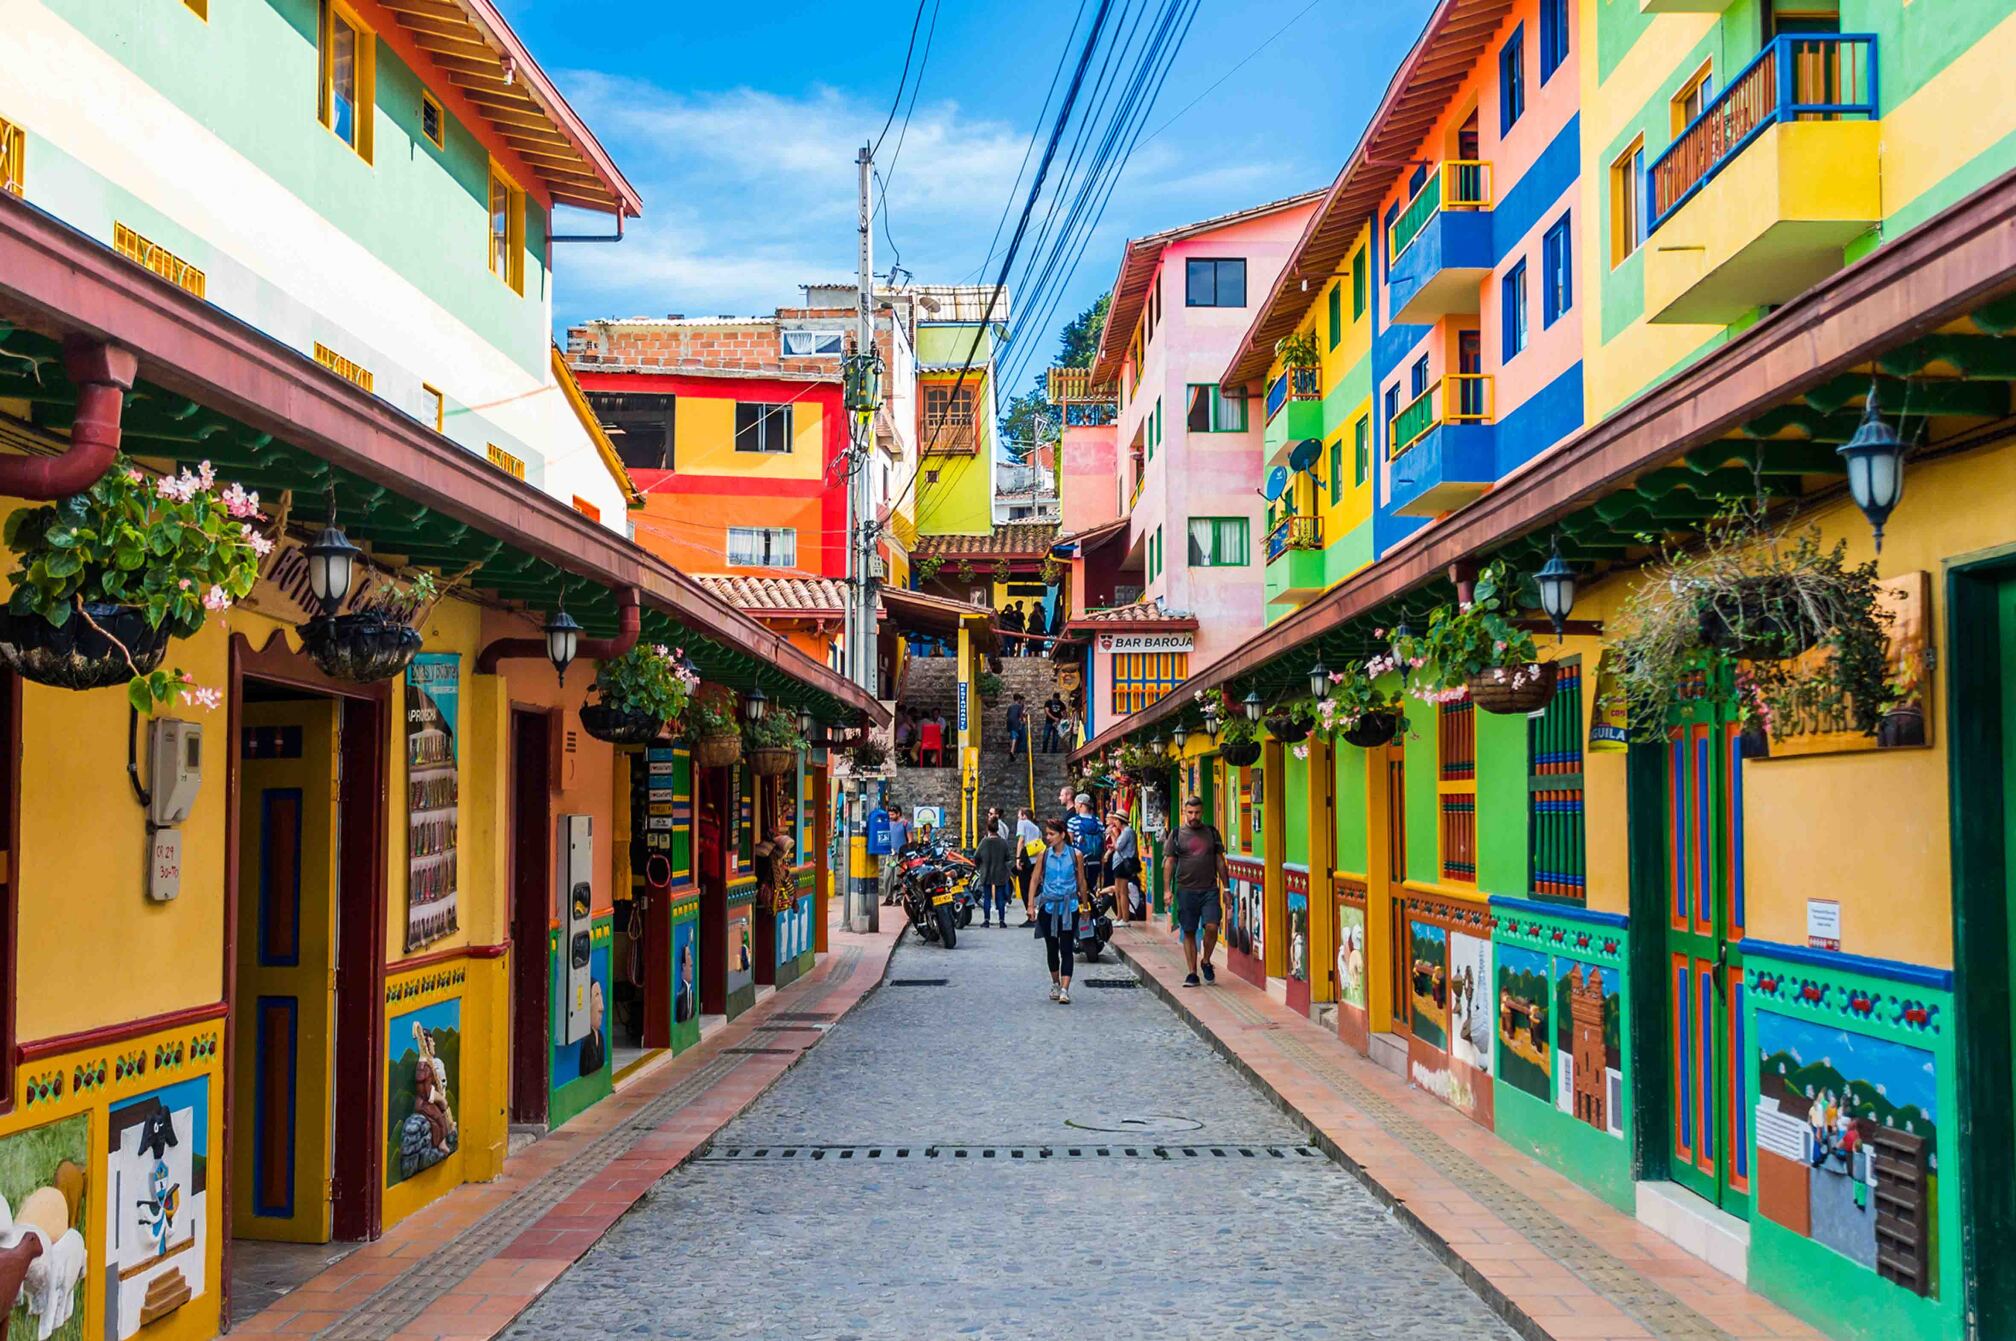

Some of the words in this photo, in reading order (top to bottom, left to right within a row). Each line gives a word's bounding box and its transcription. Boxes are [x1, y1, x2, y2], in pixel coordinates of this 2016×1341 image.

[1115, 638, 1142, 648] BAR
[1144, 637, 1193, 648] BAROJA
[1590, 727, 1626, 742] GUILA
